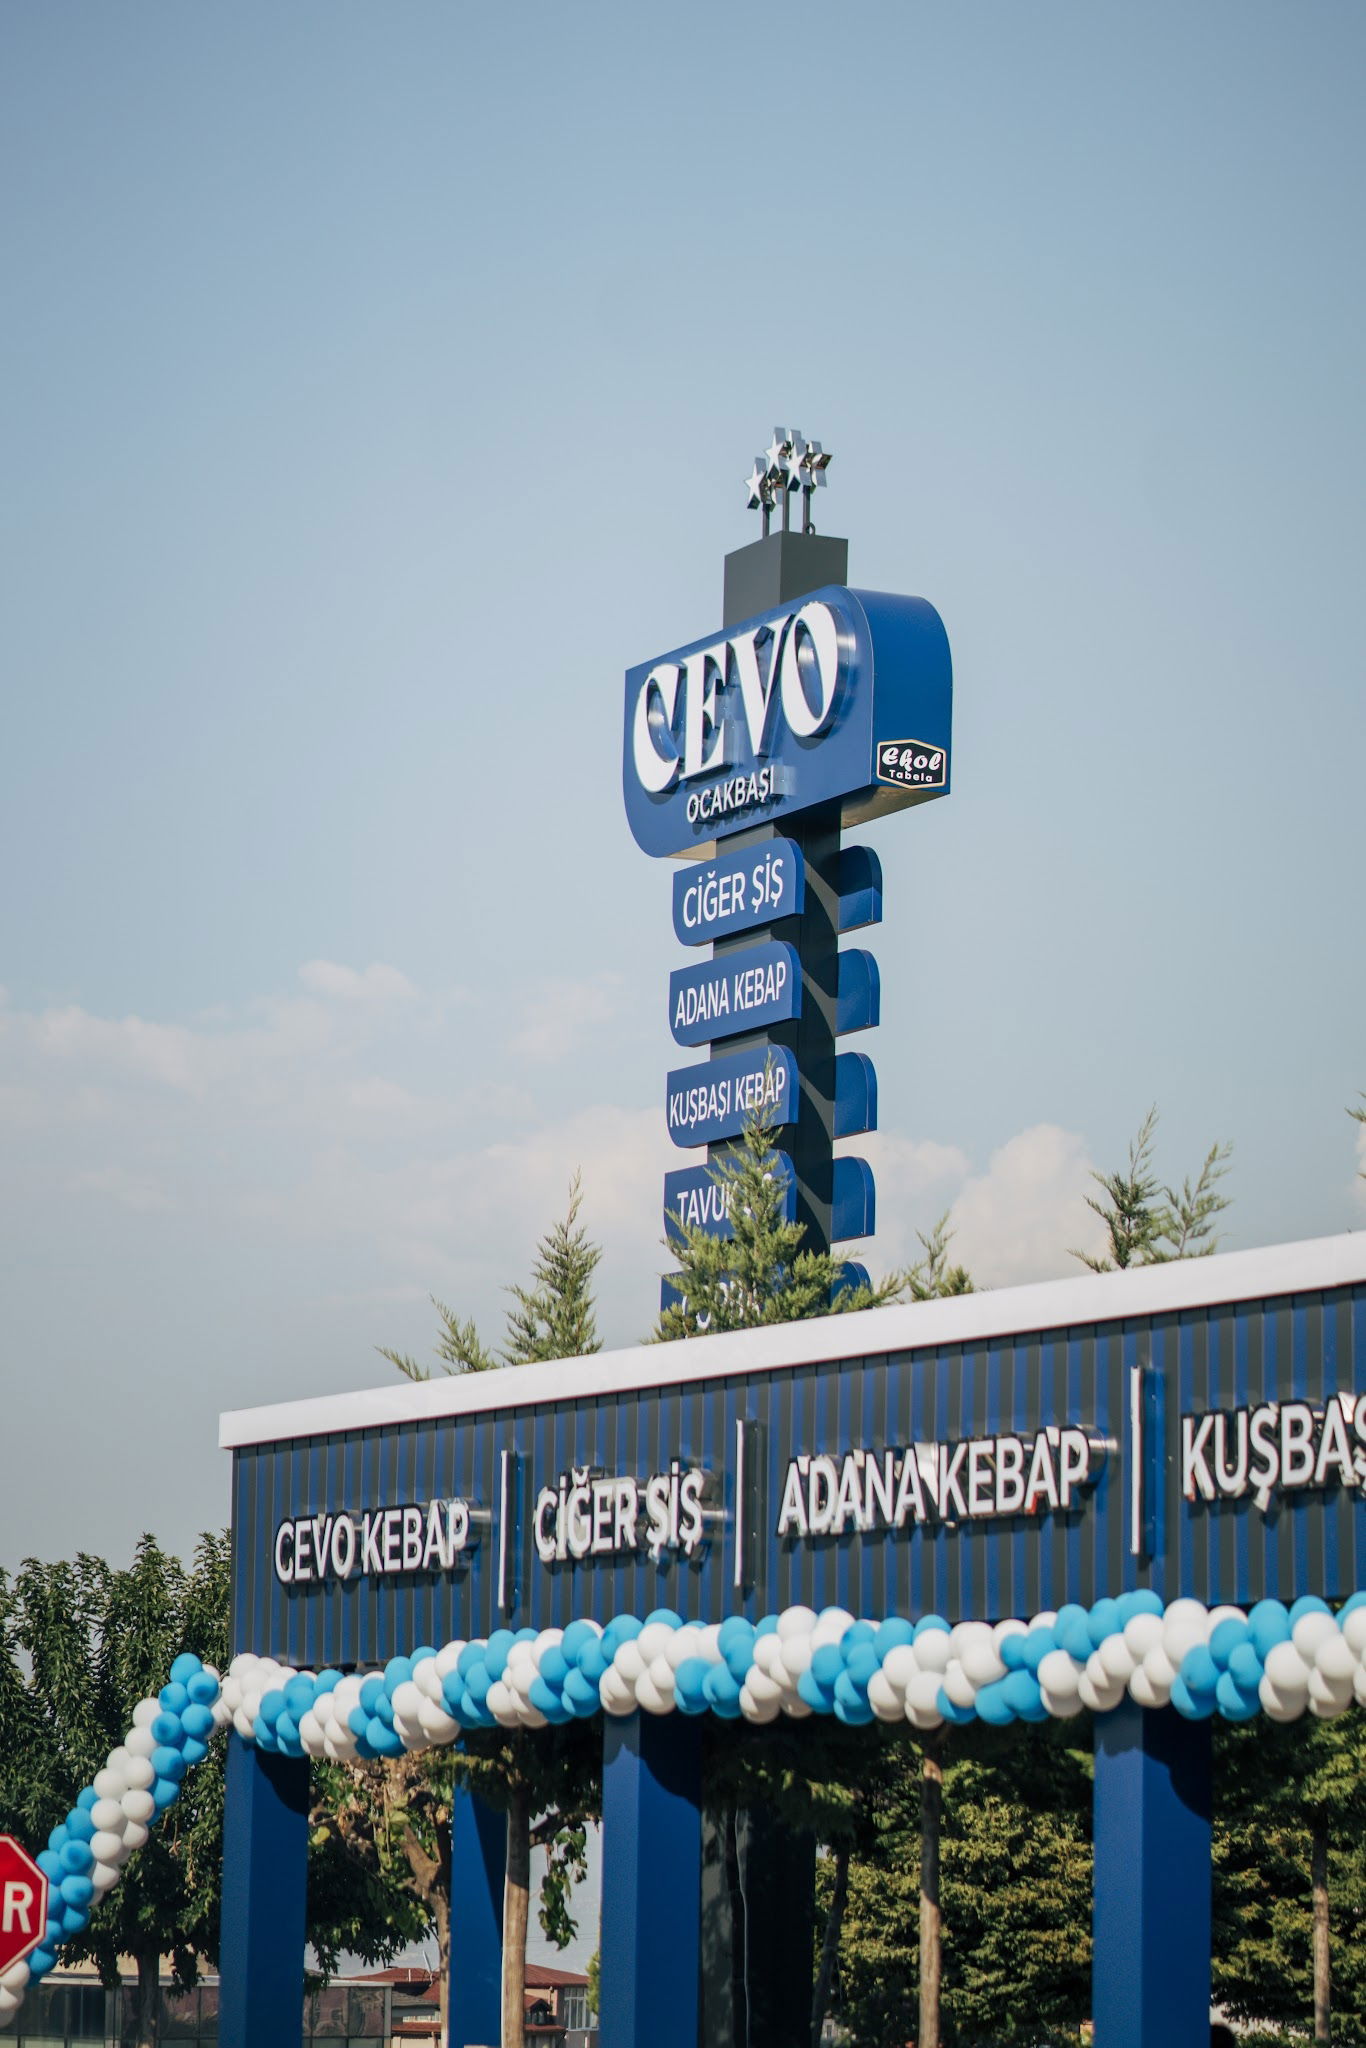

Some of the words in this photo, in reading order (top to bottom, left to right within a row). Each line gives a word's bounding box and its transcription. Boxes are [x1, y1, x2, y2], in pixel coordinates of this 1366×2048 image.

[633, 601, 840, 793] CEVO
[686, 766, 775, 824] OCAKBAŞI
[888, 769, 933, 782] Tabela
[682, 870, 746, 928] CİĞER
[751, 853, 784, 914] ŞİŞ
[674, 977, 730, 1029] ADANA
[734, 961, 786, 1012] KEBAP
[669, 1079, 731, 1129] KUŞBAŞI
[735, 1066, 786, 1112] KEBAP
[534, 1465, 637, 1562] CİĞER
[646, 1459, 704, 1564] ŞİŞ
[777, 1442, 927, 1536] ADANA
[938, 1428, 1090, 1519] KEBAP
[274, 1513, 354, 1583] CEVO
[361, 1500, 470, 1574] KEBAP
